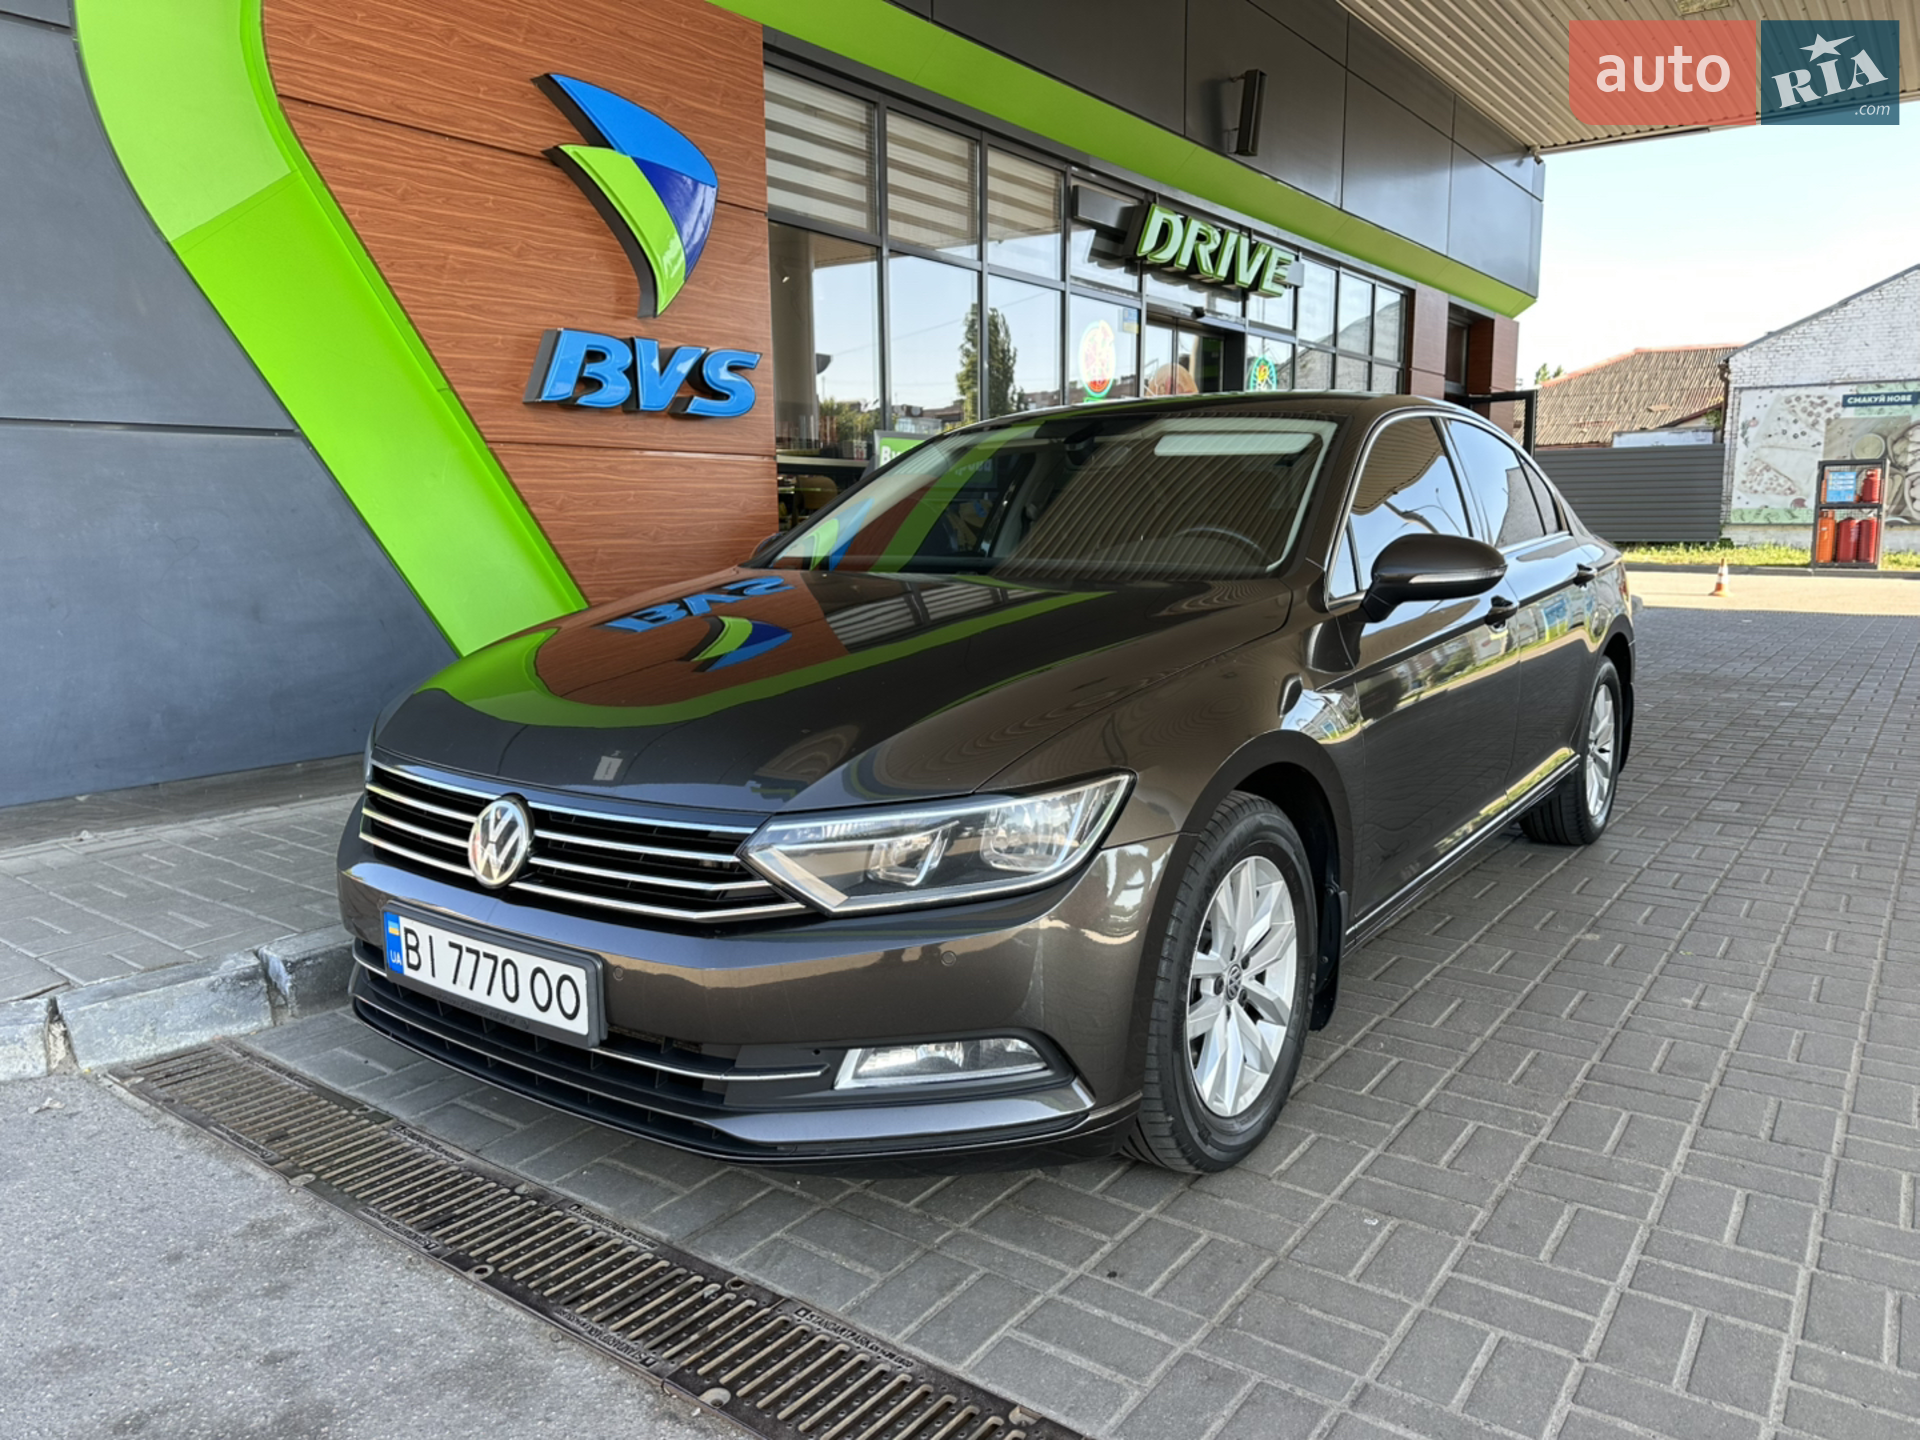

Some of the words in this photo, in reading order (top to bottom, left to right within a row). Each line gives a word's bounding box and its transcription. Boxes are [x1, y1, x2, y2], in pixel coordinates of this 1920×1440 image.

[1136, 203, 1296, 298] DRIVE
[536, 327, 763, 418] BVS
[1847, 394, 1886, 404] СМАКУЙ
[1887, 394, 1912, 403] НОВЕ
[390, 949, 402, 966] UA
[403, 926, 436, 978] BI
[448, 940, 520, 1004] 7770
[529, 965, 581, 1021] OO
